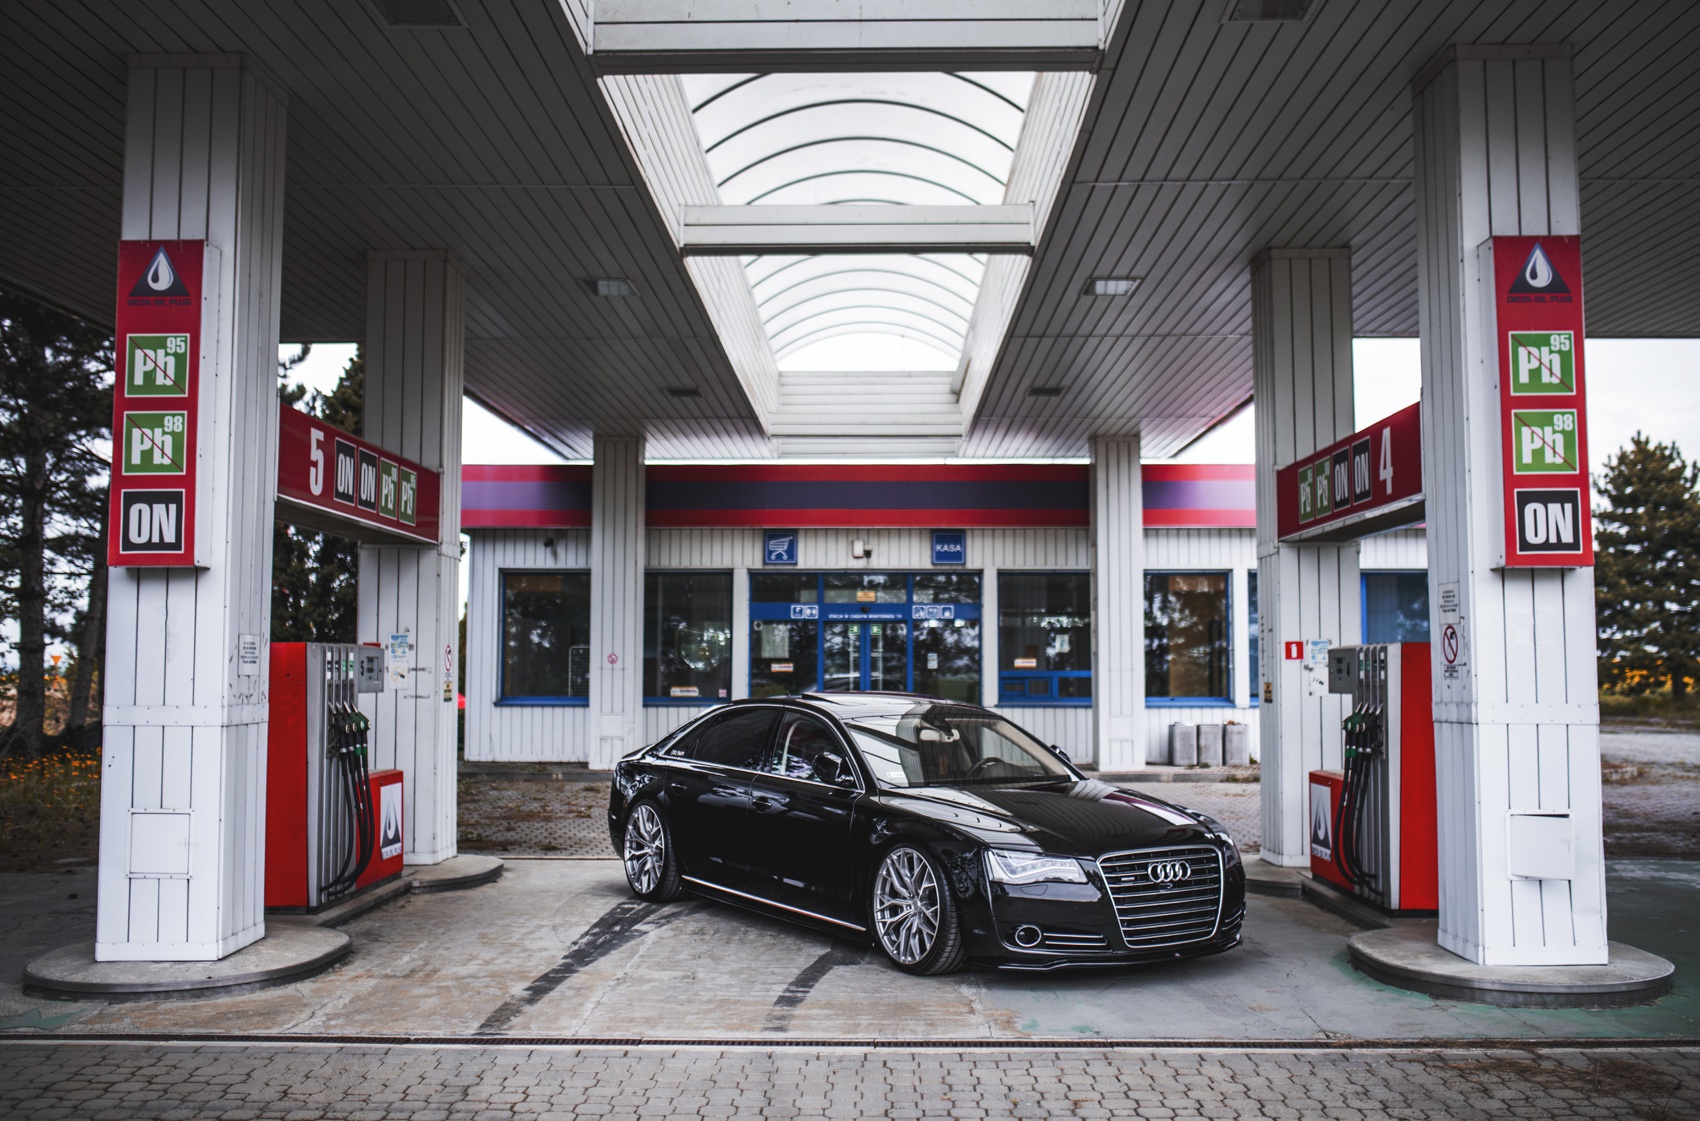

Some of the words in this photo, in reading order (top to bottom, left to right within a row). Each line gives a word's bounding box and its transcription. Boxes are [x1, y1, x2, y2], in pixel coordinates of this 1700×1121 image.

[309, 427, 325, 496] 5
[337, 453, 354, 496] ON
[360, 462, 376, 504] ON
[1334, 461, 1348, 503] ON
[1354, 451, 1370, 495] ON
[1379, 426, 1393, 496] 4
[128, 502, 176, 544] ON
[1524, 502, 1574, 544] ON
[935, 544, 961, 553] KASA
